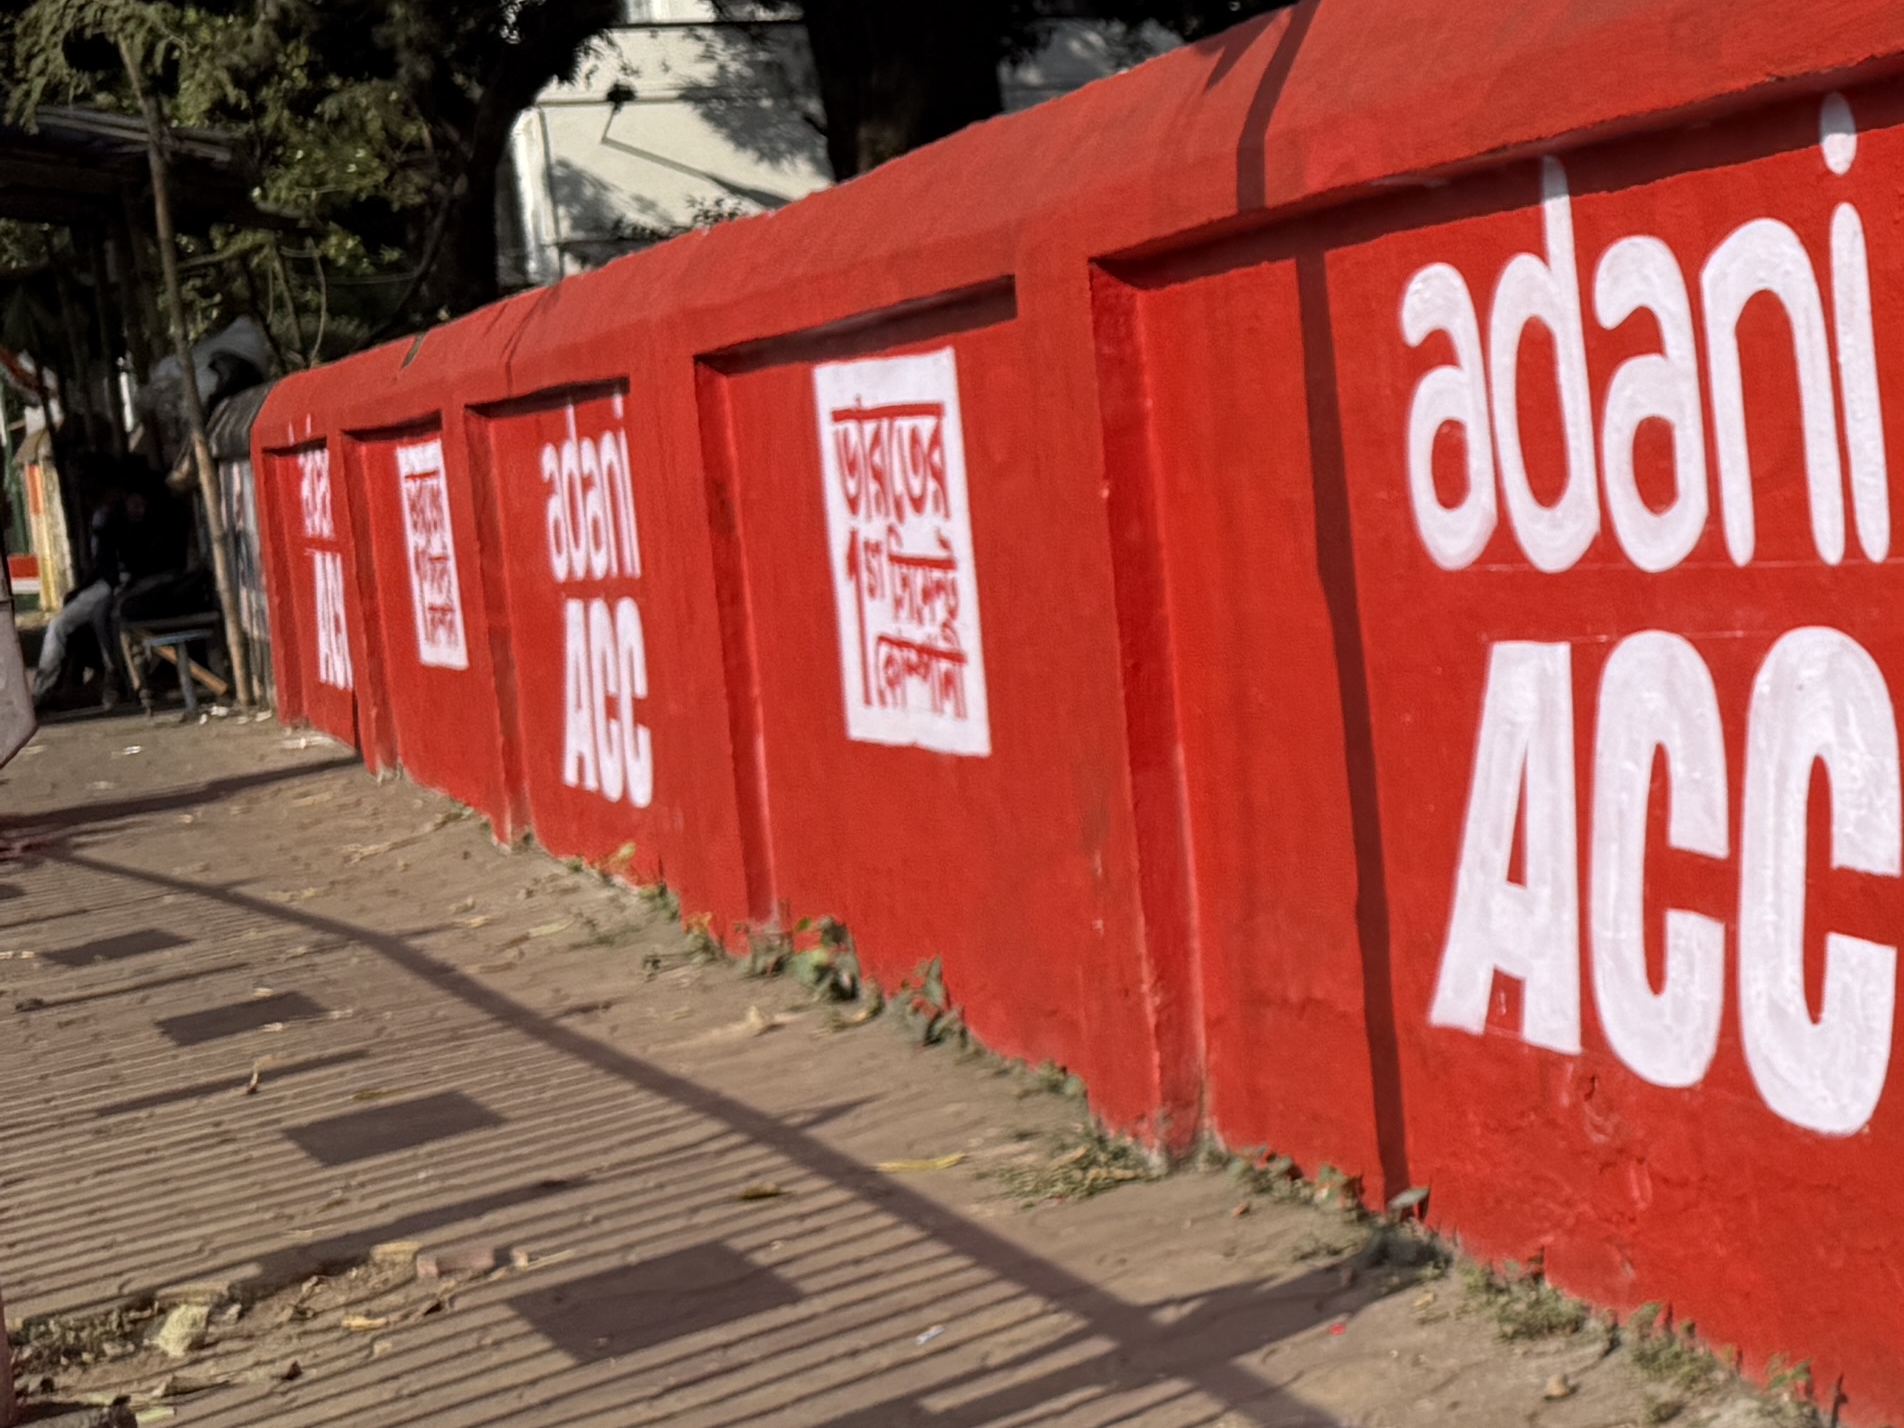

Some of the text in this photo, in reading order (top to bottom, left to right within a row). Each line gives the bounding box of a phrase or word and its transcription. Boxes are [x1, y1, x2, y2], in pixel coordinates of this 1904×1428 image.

[1402, 91, 1889, 571] adani
[541, 387, 642, 584] adani
[831, 394, 951, 523] ভারতের
[562, 596, 653, 809] ACC
[1428, 625, 1902, 1137] ACC
